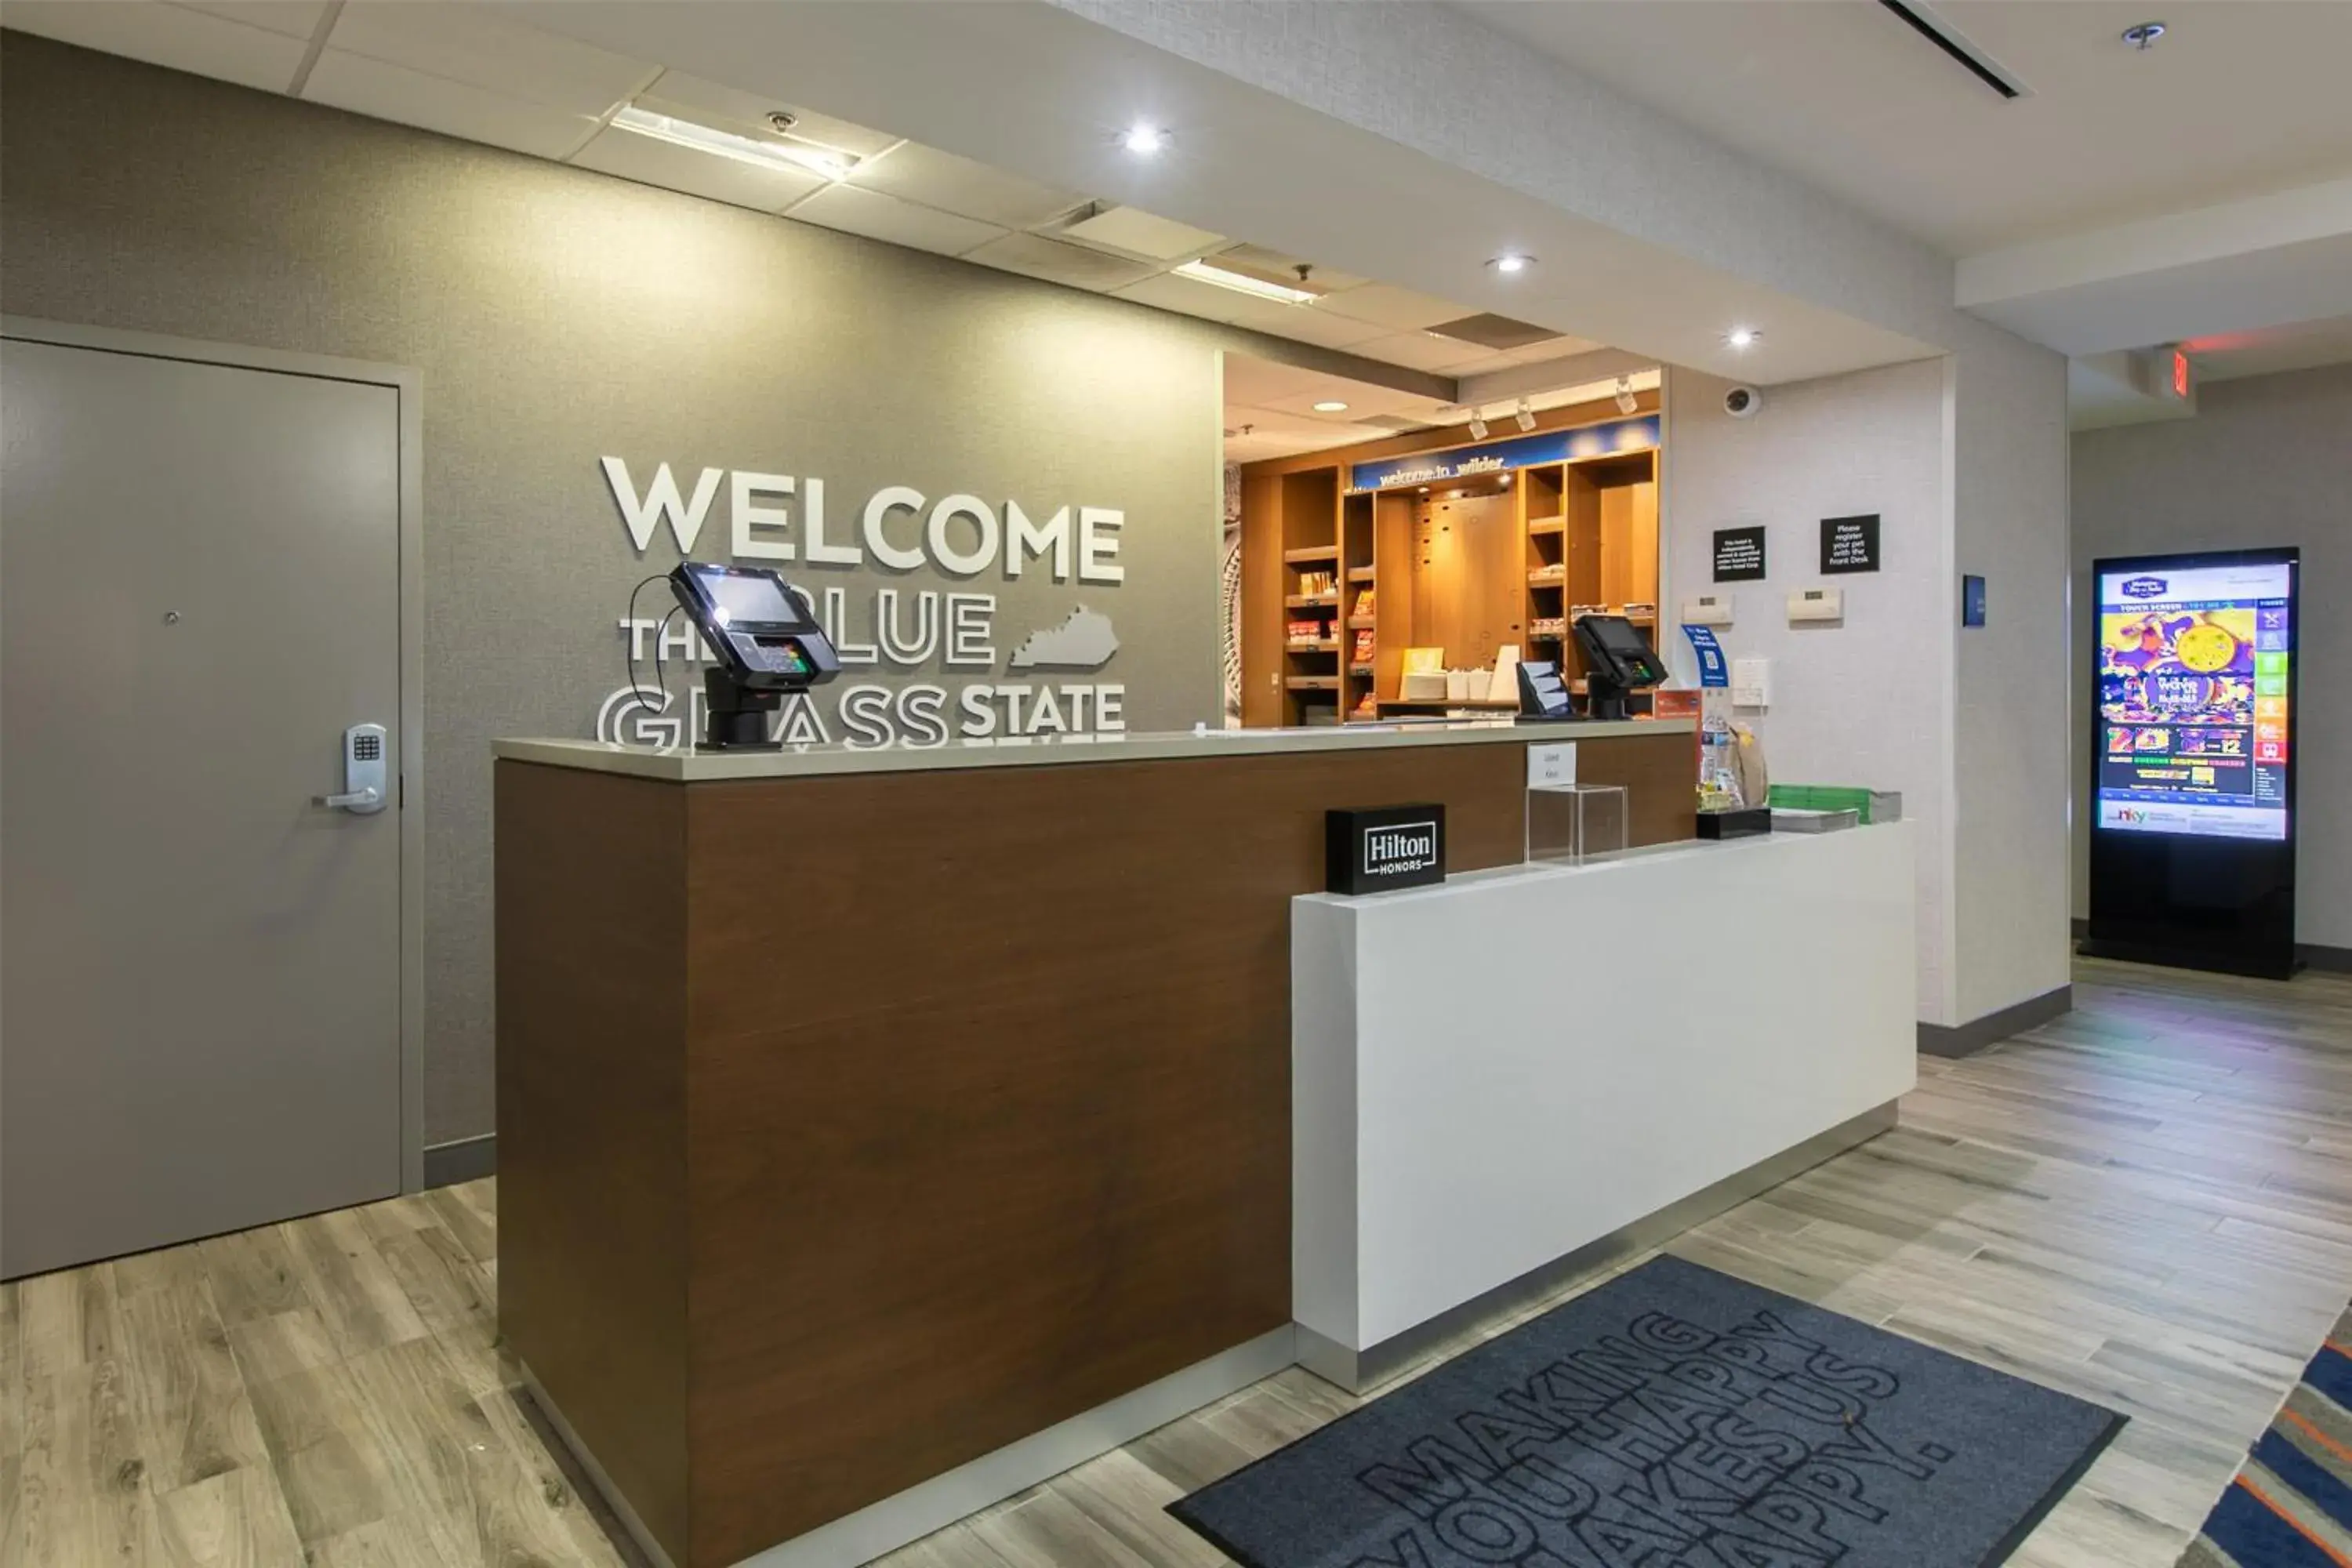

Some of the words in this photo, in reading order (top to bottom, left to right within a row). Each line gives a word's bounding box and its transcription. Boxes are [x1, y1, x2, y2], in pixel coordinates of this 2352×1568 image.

[601, 456, 1124, 582] WELCOME
[1832, 542, 1849, 550] your
[1851, 539, 1865, 548] pet
[1833, 548, 1850, 557] with
[1850, 555, 1869, 564] Desk
[788, 584, 996, 666] LUE
[960, 684, 1125, 736] STATE
[1371, 834, 1430, 861] Hilton
[1380, 859, 1422, 875] HONORS
[1566, 1309, 1826, 1474] HAPPY
[1356, 1311, 1723, 1521] MAKING
